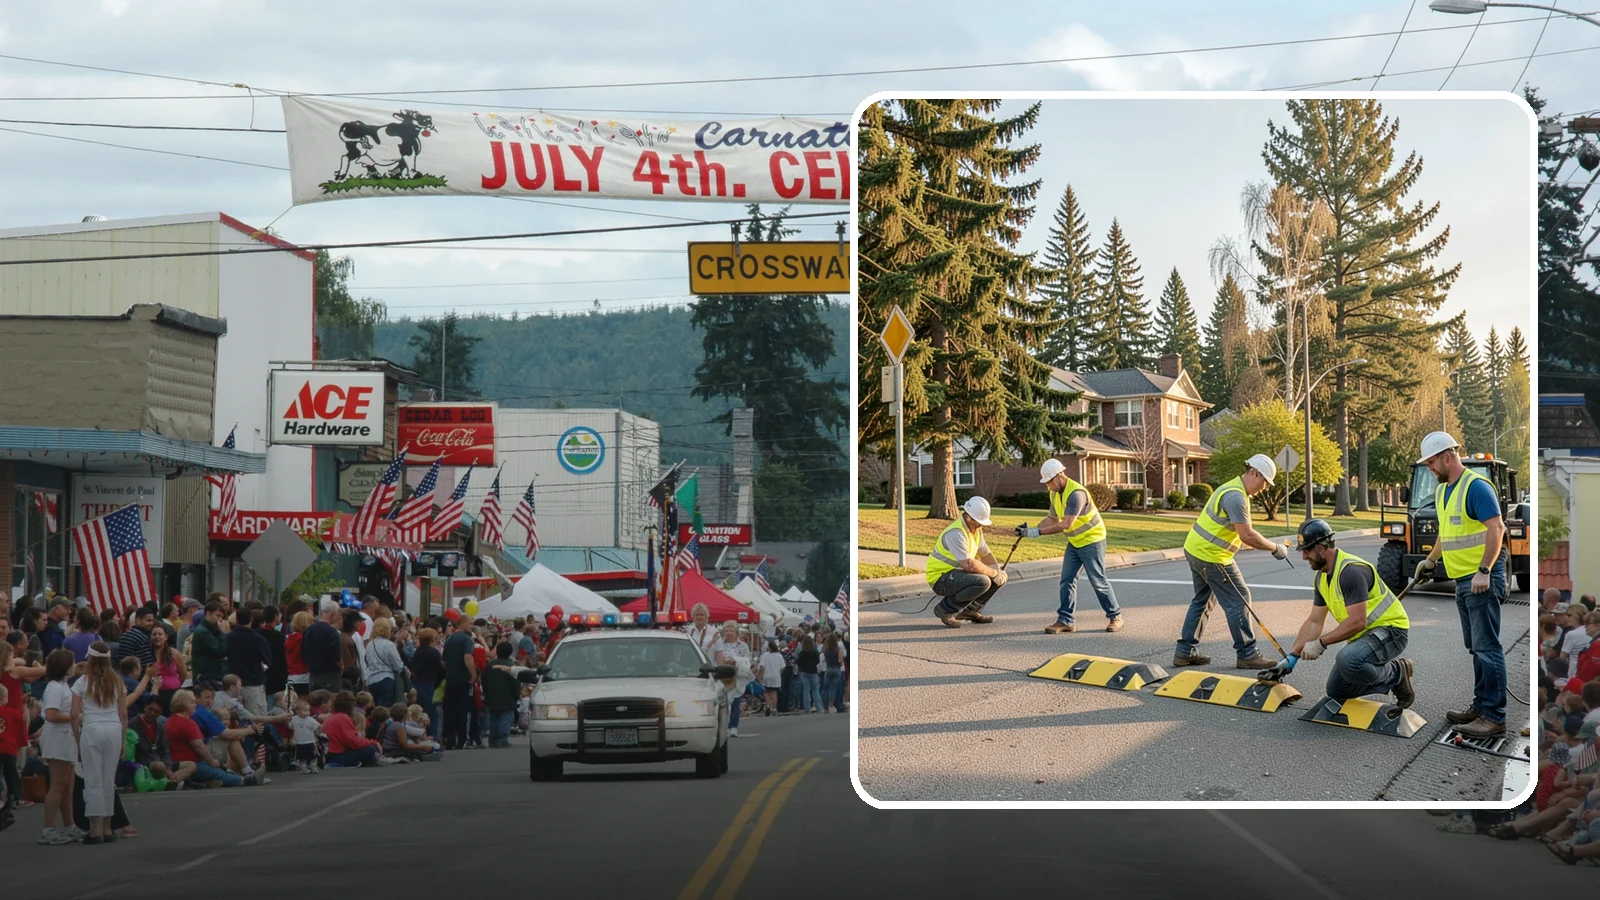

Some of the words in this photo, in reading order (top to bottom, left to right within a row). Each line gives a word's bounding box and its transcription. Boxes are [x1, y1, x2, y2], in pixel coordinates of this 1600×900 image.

[695, 121, 850, 149] Carnat
[480, 141, 604, 192] JULY
[631, 150, 746, 197] 4th.
[697, 254, 850, 279] CROSSWA
[282, 380, 373, 420] ACE
[406, 409, 453, 422] CEDAR
[283, 421, 371, 436] Hardware
[416, 428, 477, 447] Coca-Cola
[353, 467, 385, 480] Simpl
[83, 484, 93, 494] St.
[95, 484, 124, 494] Vincent
[126, 486, 136, 494] de
[137, 486, 155, 495] Paul
[688, 526, 741, 535] CRNATION
[699, 535, 730, 543] GLASS
